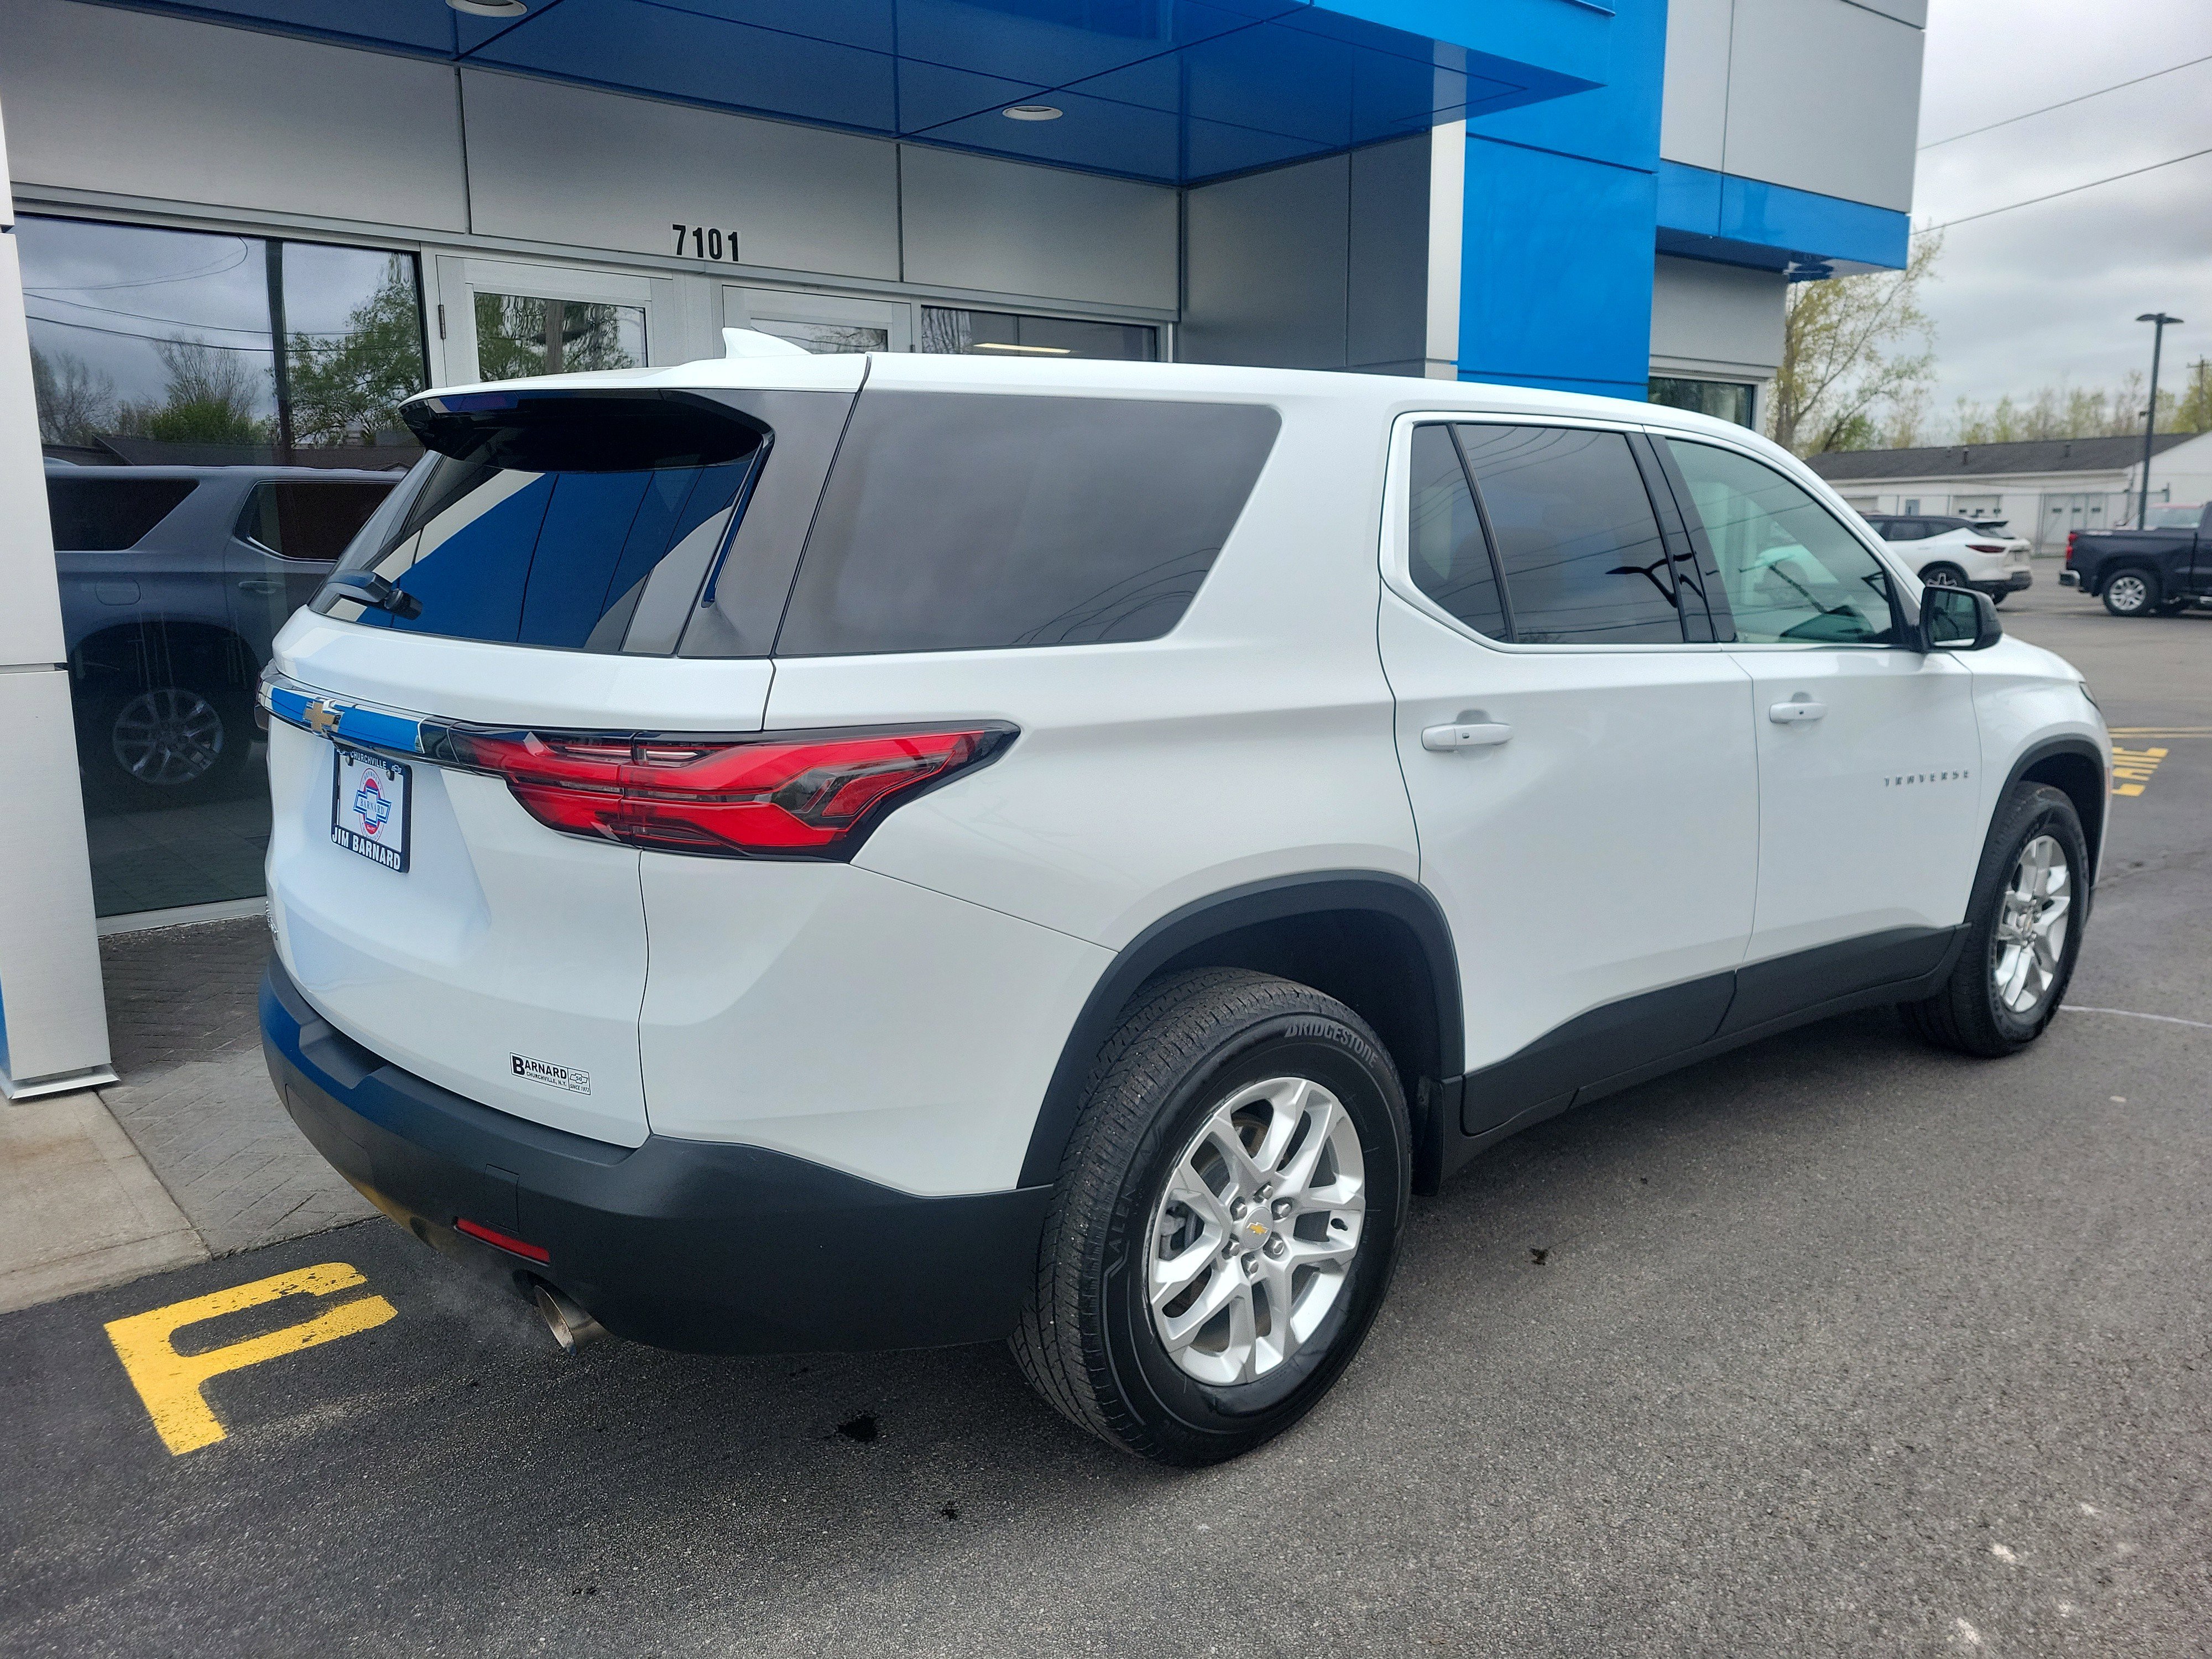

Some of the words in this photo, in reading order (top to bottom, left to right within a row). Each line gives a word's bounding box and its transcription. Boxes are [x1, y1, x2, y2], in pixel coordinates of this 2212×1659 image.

[672, 223, 739, 262] 7101
[350, 751, 387, 770] CHURCHVILLE
[1884, 769, 1968, 787] TRAVERSE
[360, 798, 384, 815] BARNARD
[332, 827, 349, 848] JIM
[352, 834, 401, 870] BARNARD
[1284, 1022, 1379, 1068] BRIDGESTONE
[512, 1055, 567, 1079] BARNARD
